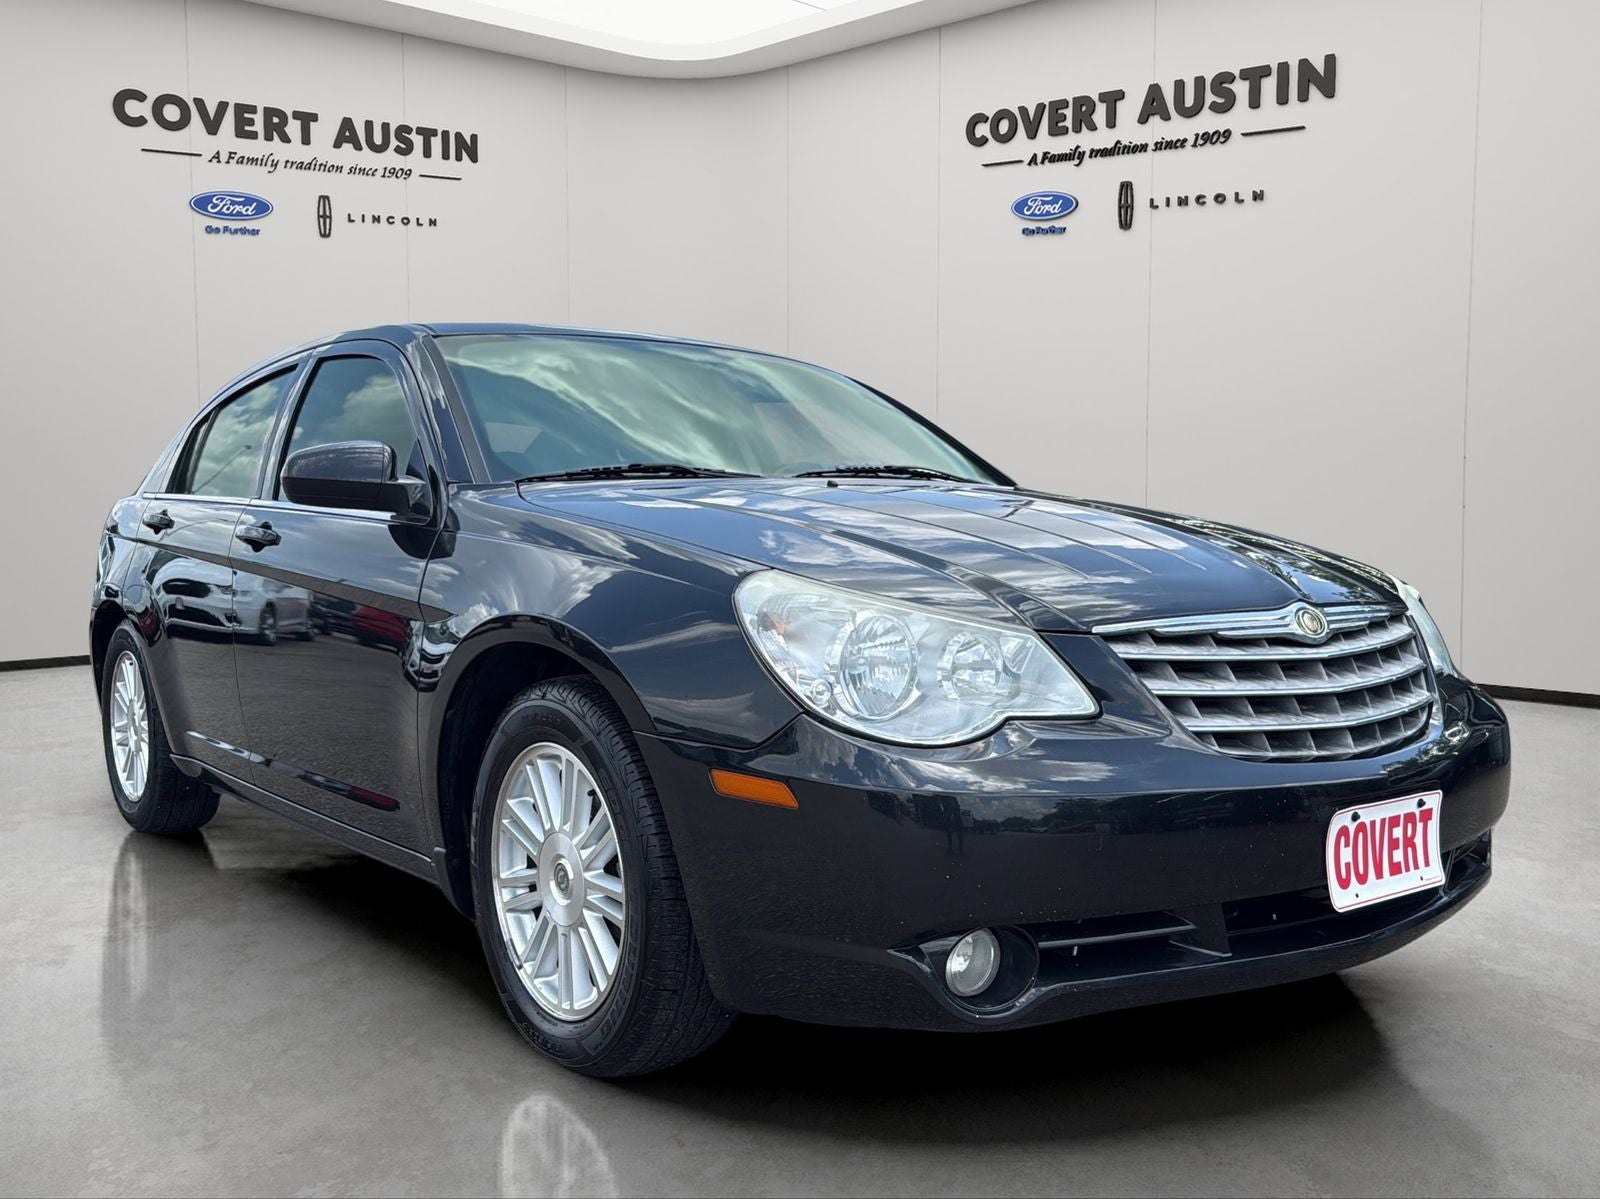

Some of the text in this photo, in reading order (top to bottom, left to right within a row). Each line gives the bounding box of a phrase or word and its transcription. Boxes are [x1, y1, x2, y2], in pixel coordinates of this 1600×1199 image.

[966, 54, 1337, 147] COVERT AUSTIN
[112, 88, 479, 163] COVERT AUSTIN
[1027, 128, 1232, 167] A Family tradition since 1909
[208, 150, 412, 180] A Family tradition since 1909
[207, 195, 257, 215] Ford
[1024, 196, 1063, 215] Ford
[1149, 189, 1265, 209] LINCOLN
[222, 226, 261, 236] Further
[347, 213, 438, 227] LINCOLN
[1334, 808, 1433, 890] COVERT
